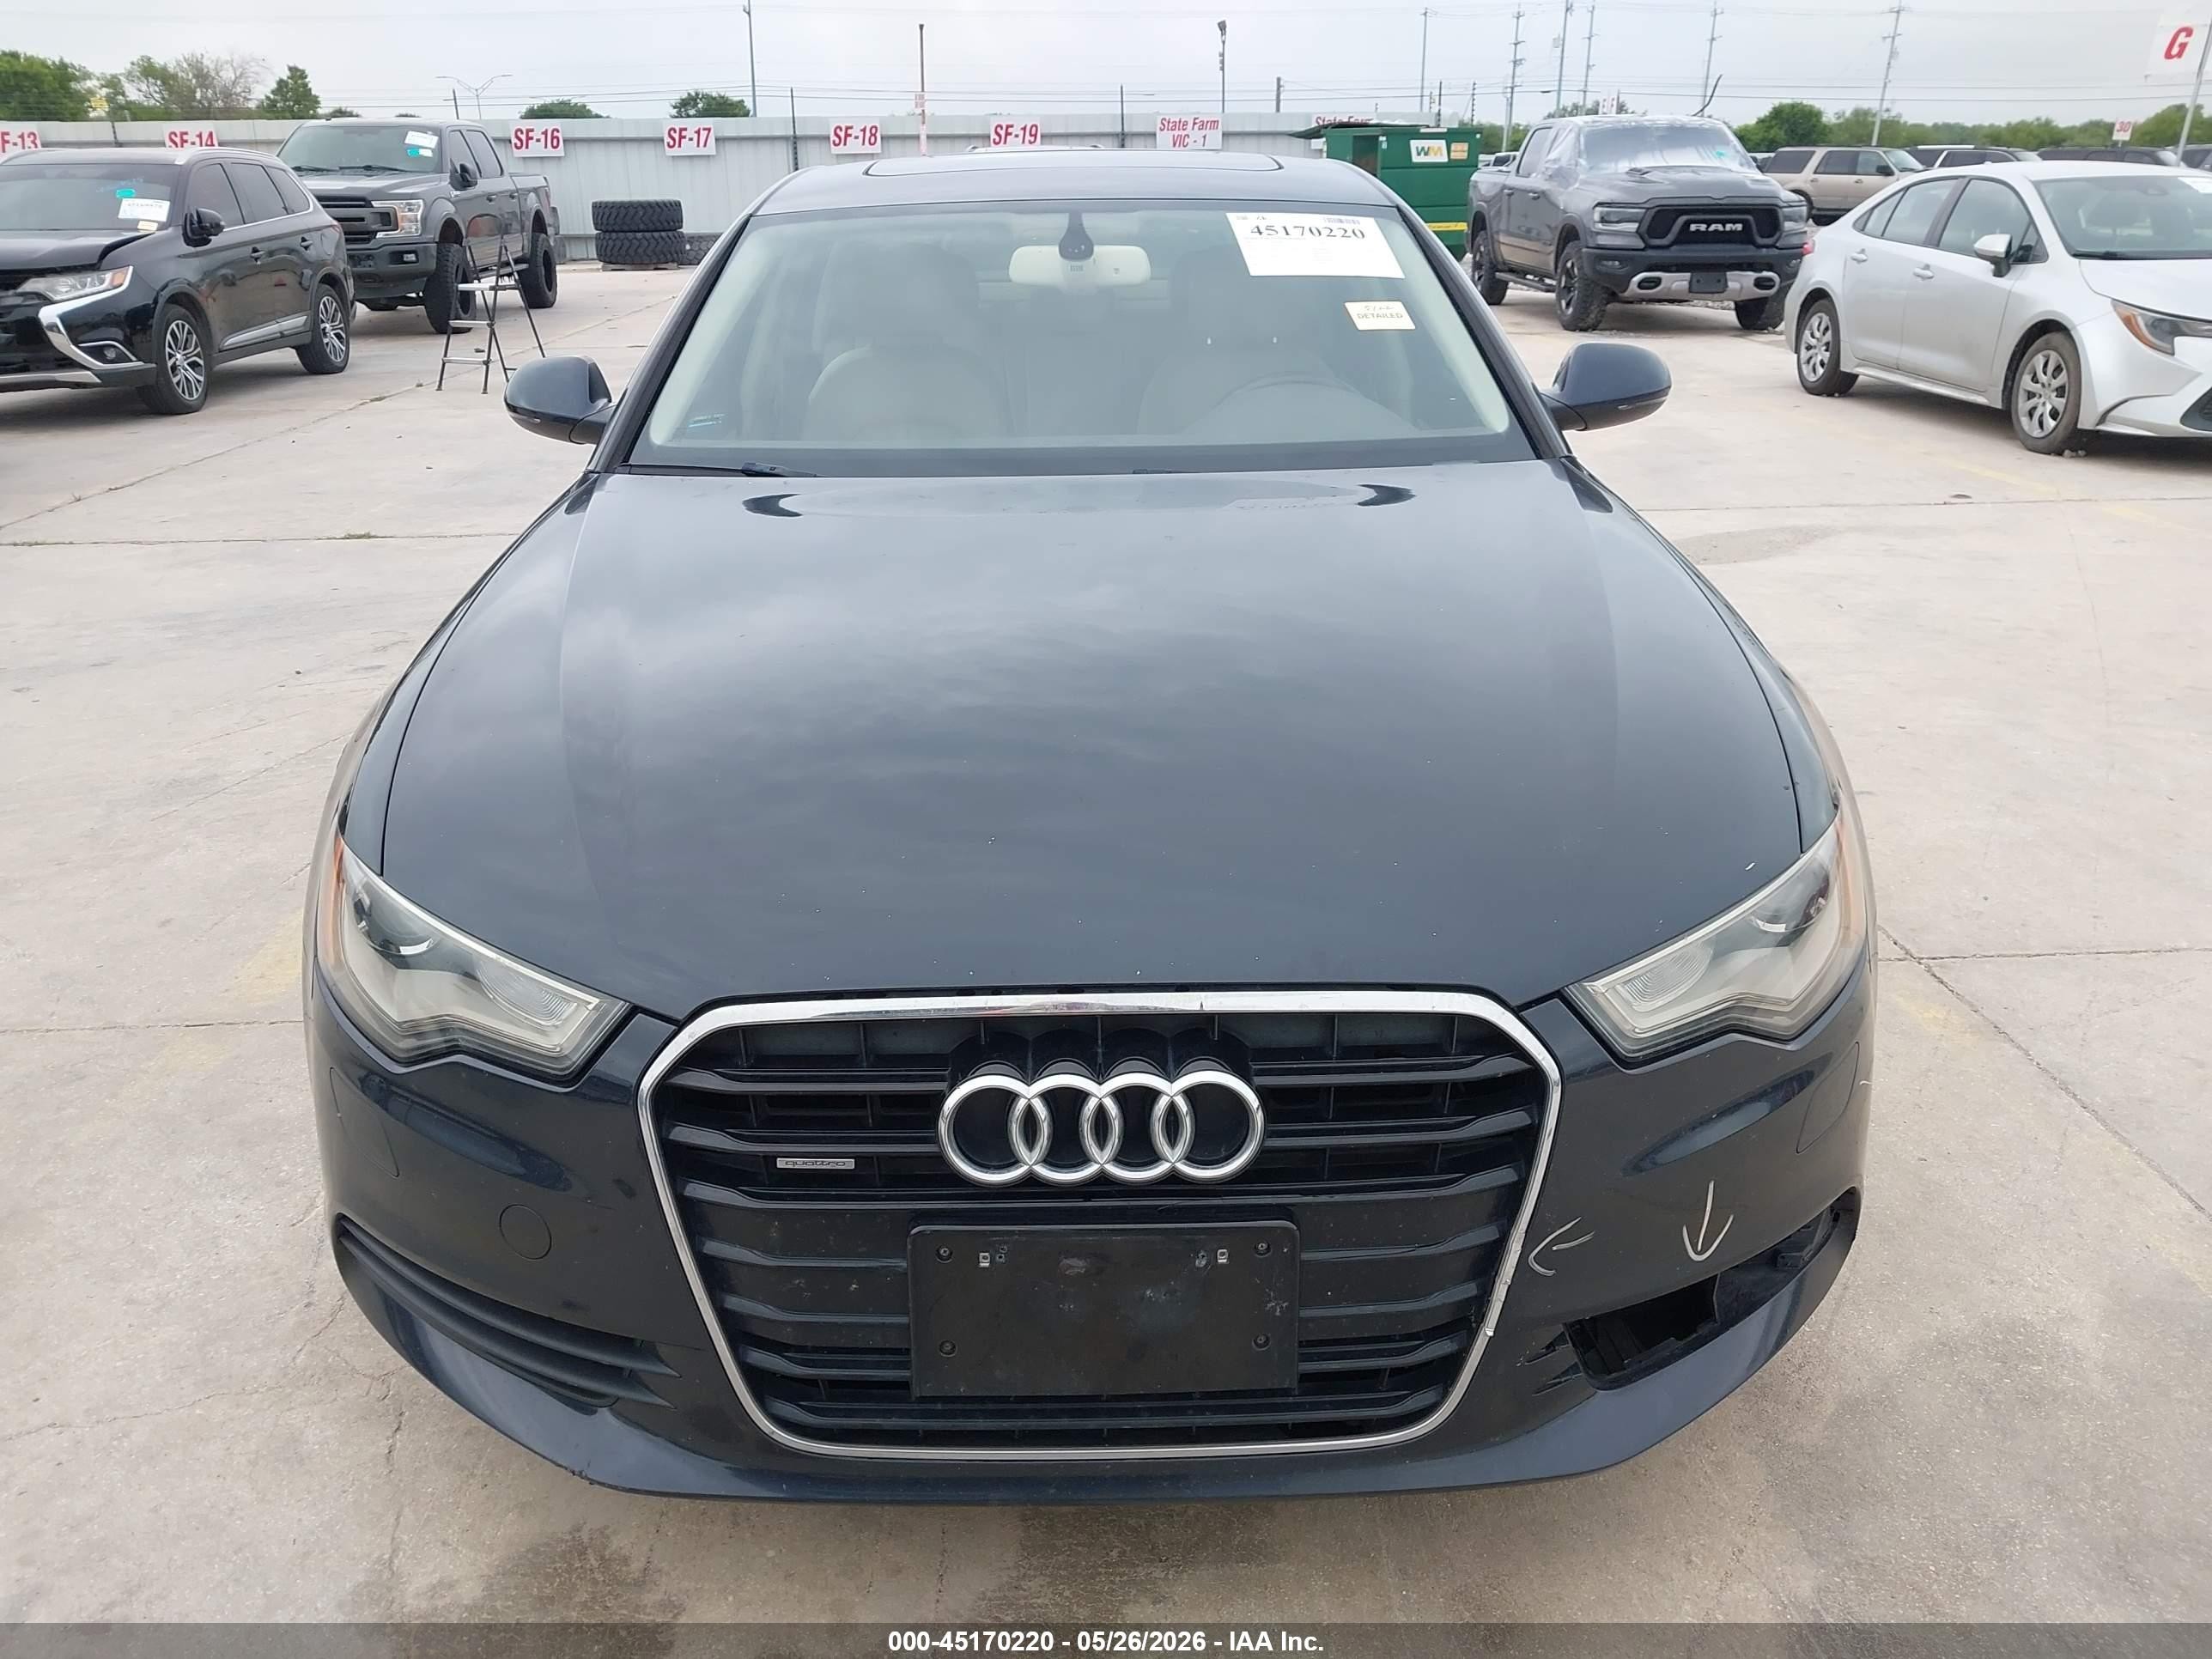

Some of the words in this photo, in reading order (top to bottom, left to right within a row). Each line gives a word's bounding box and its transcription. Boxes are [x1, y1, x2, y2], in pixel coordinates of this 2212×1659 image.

[2164, 27, 2194, 60] G
[1159, 117, 1189, 131] State
[1192, 117, 1219, 131] Farm
[2117, 121, 2130, 132] 30
[167, 131, 216, 148] SF-14
[514, 128, 561, 150] SF-16
[666, 127, 712, 149] SF-17
[832, 125, 878, 147] SF-18
[993, 124, 1038, 146] SF-19
[1172, 134, 1189, 148] VIC
[1201, 134, 1207, 148] 1
[1416, 146, 1443, 156] WM
[1250, 224, 1365, 240] 45170220
[1690, 223, 1742, 232] RAM
